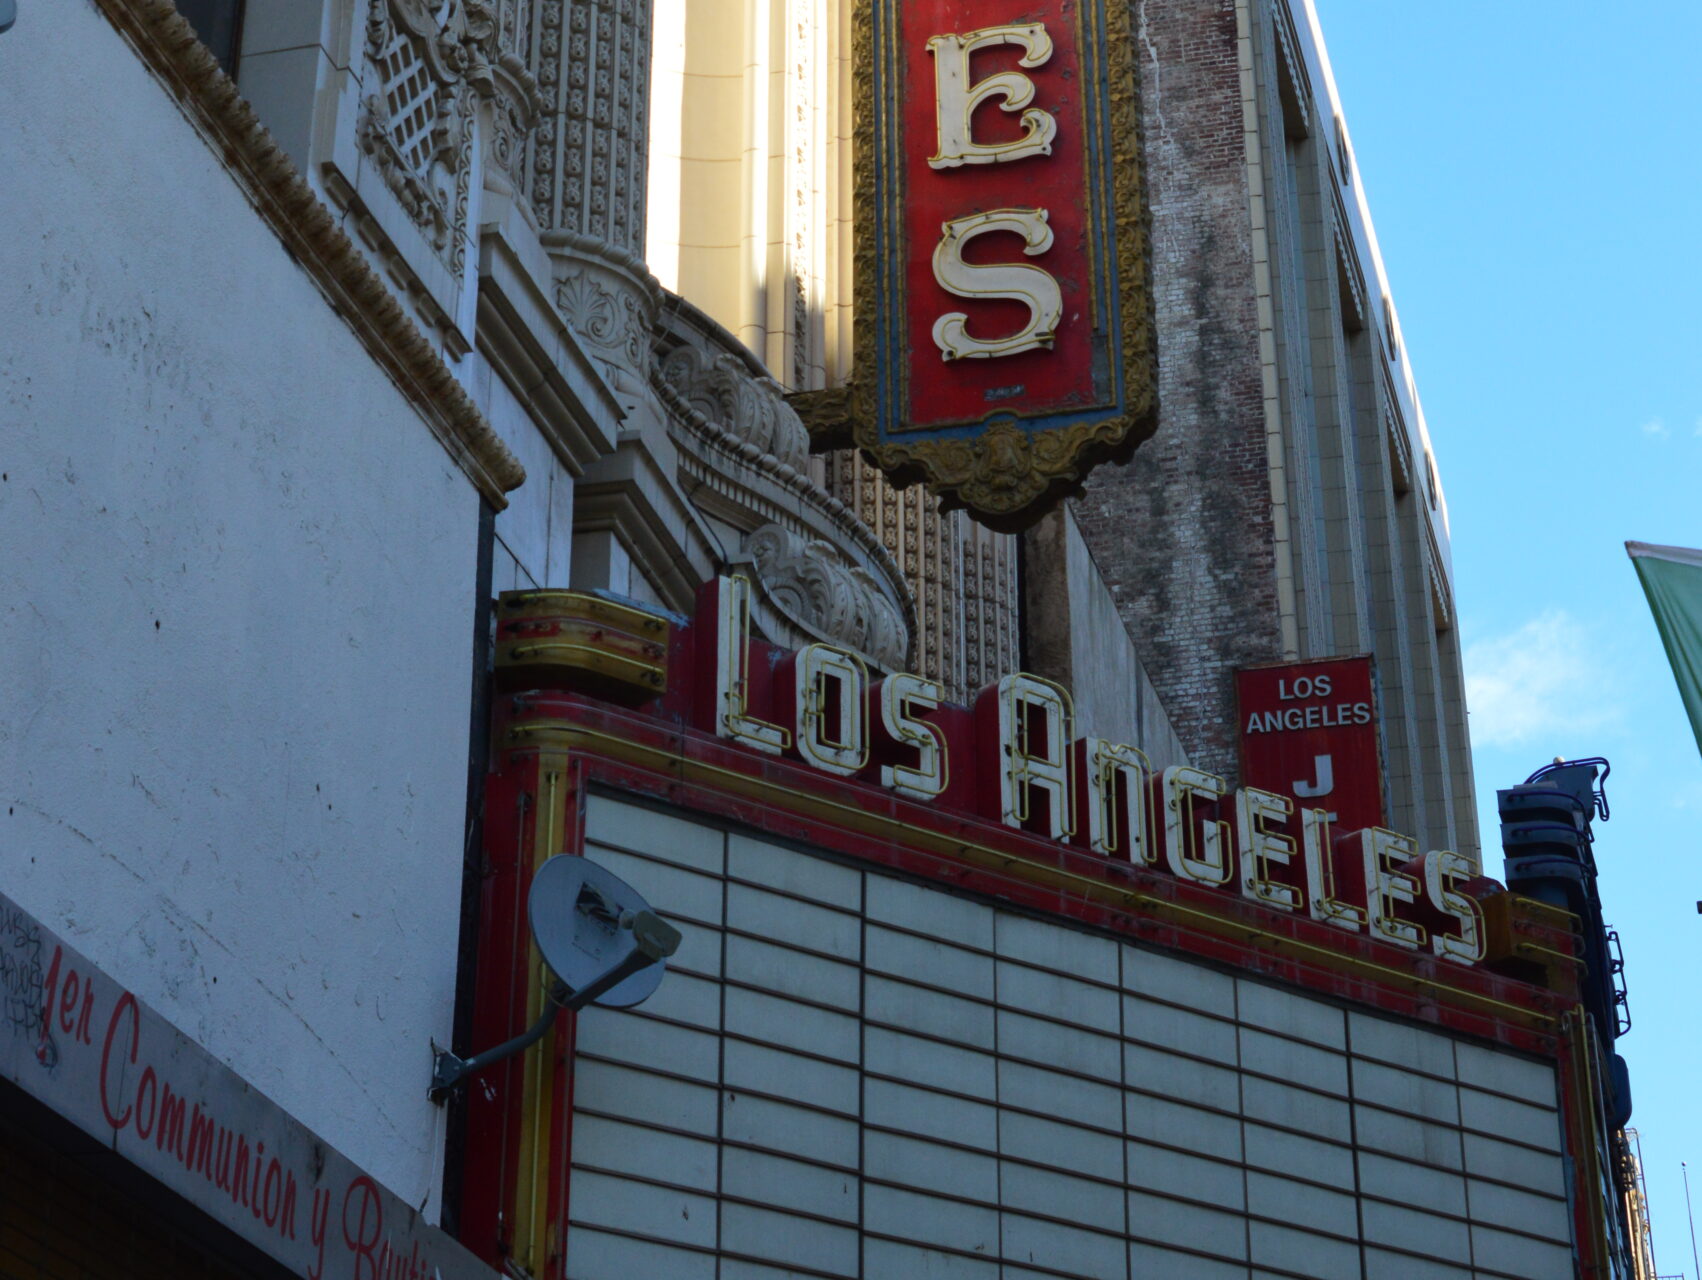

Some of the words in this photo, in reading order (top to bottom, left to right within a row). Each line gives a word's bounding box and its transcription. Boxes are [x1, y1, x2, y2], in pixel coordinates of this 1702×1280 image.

[716, 574, 949, 801] LOS
[1246, 702, 1371, 734] ANGELES
[1278, 675, 1332, 700] LOS
[100, 992, 297, 1241] Communion
[307, 1188, 331, 1280] y
